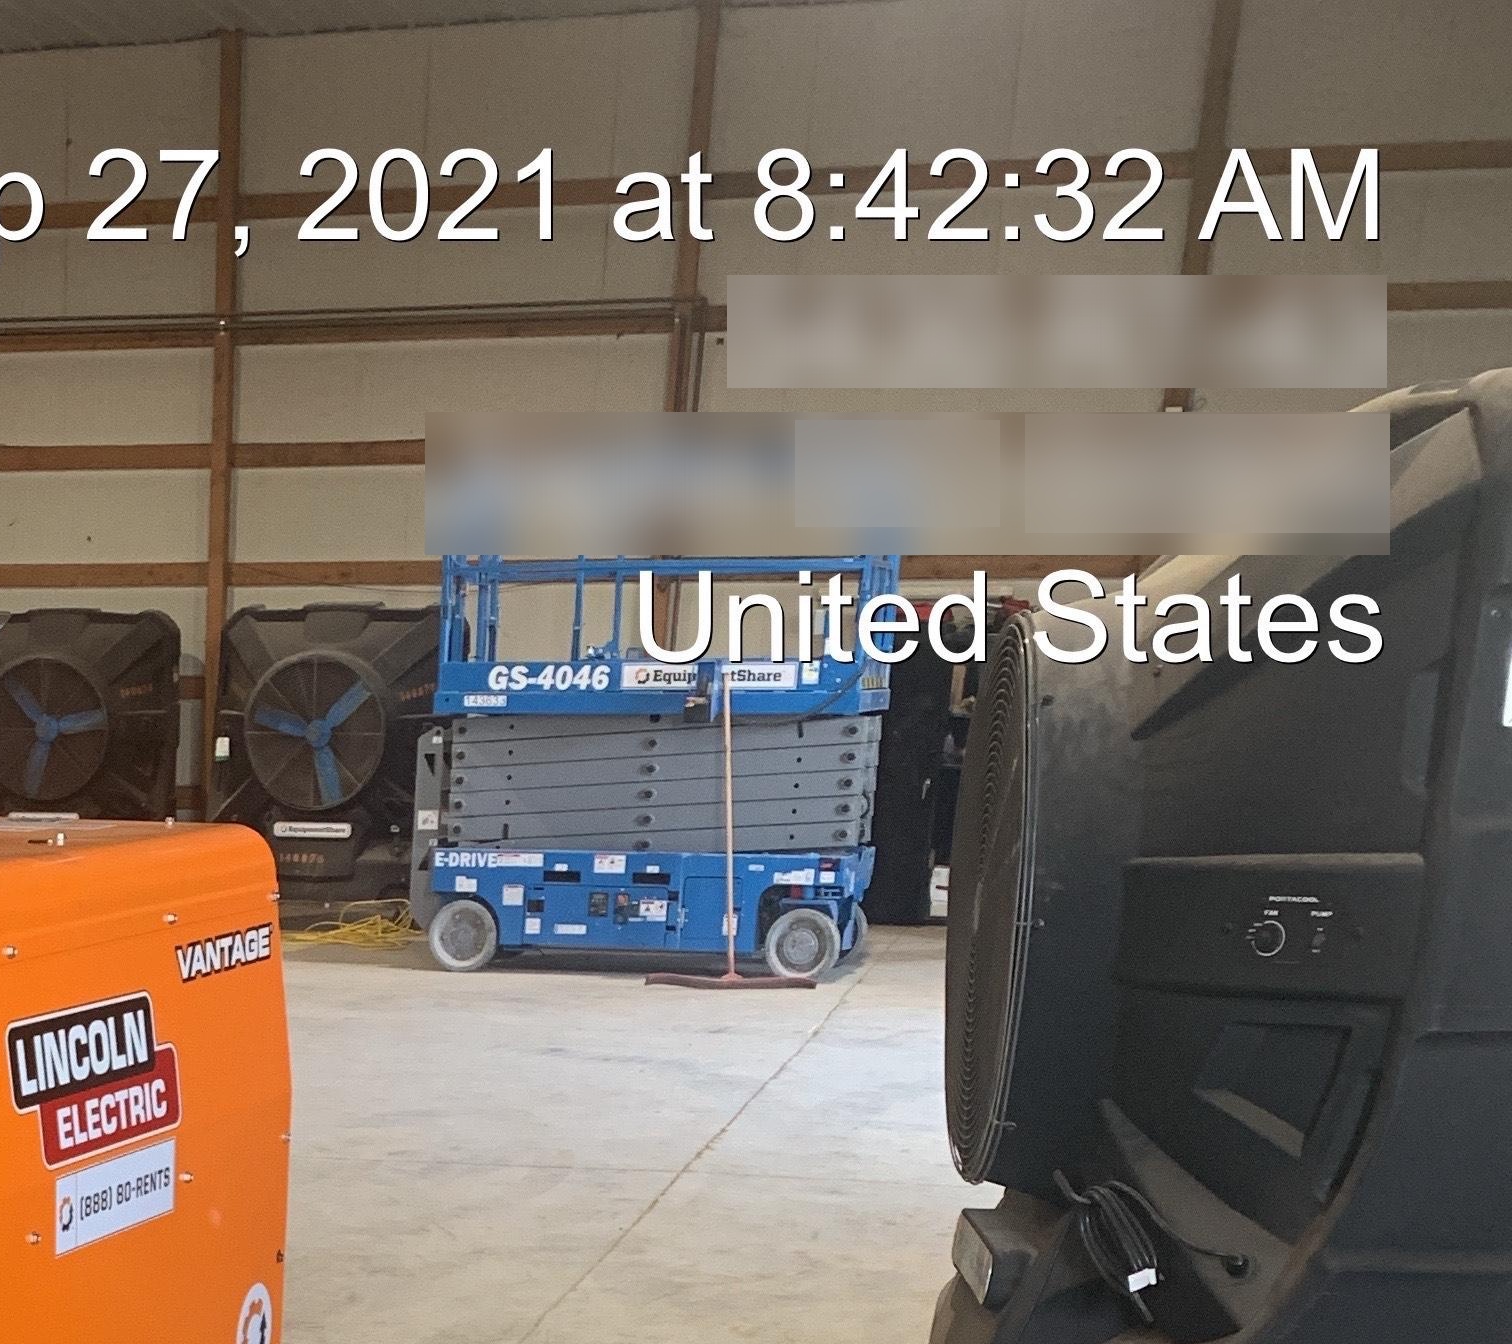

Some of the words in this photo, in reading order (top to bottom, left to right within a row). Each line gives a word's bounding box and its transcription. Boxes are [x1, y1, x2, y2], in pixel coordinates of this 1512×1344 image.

[488, 664, 612, 691] GS-4046
[435, 851, 498, 868] E-DRIVE
[175, 924, 272, 982] VANTAGE
[16, 1009, 149, 1097] LINCOLN
[56, 1078, 168, 1150] ELECTRIC
[79, 1186, 113, 1221] (888)
[116, 1166, 171, 1206] 80-RENTS
